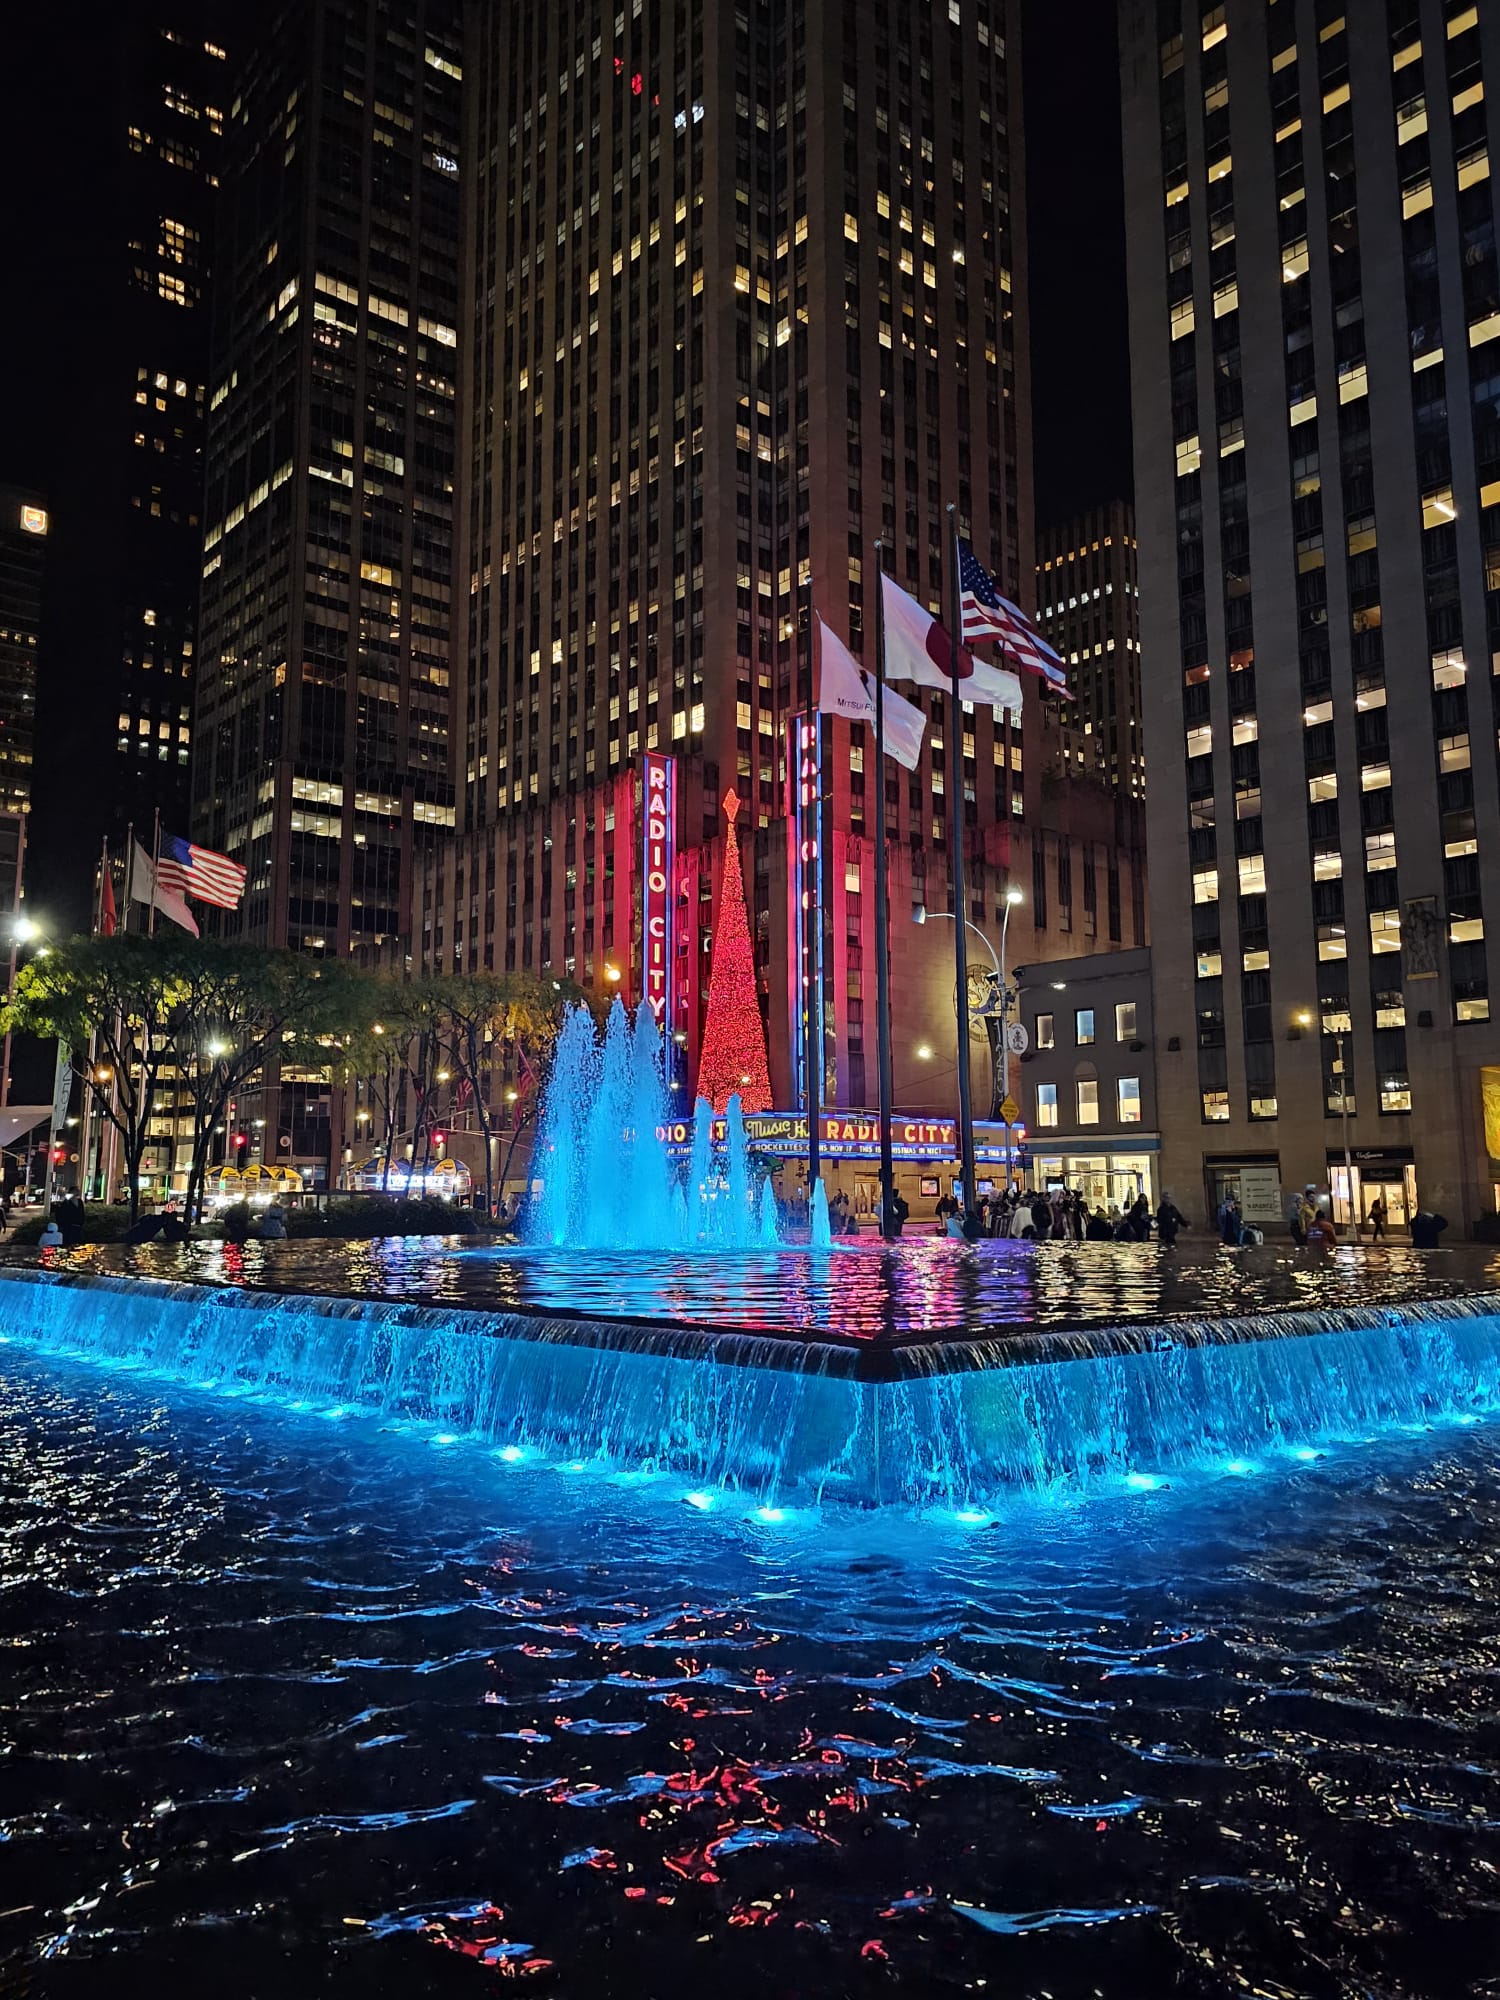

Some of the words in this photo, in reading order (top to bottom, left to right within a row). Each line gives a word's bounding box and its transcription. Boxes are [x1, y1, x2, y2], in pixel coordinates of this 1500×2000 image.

[801, 725, 818, 863] RADO
[649, 767, 667, 894] RADIO
[648, 916, 666, 1017] CITY
[655, 1123, 686, 1142] DIO
[746, 1120, 791, 1139] Music
[755, 1143, 803, 1151] ROCKETTES
[827, 1120, 893, 1142] RADI
[904, 1124, 951, 1143] CITY
